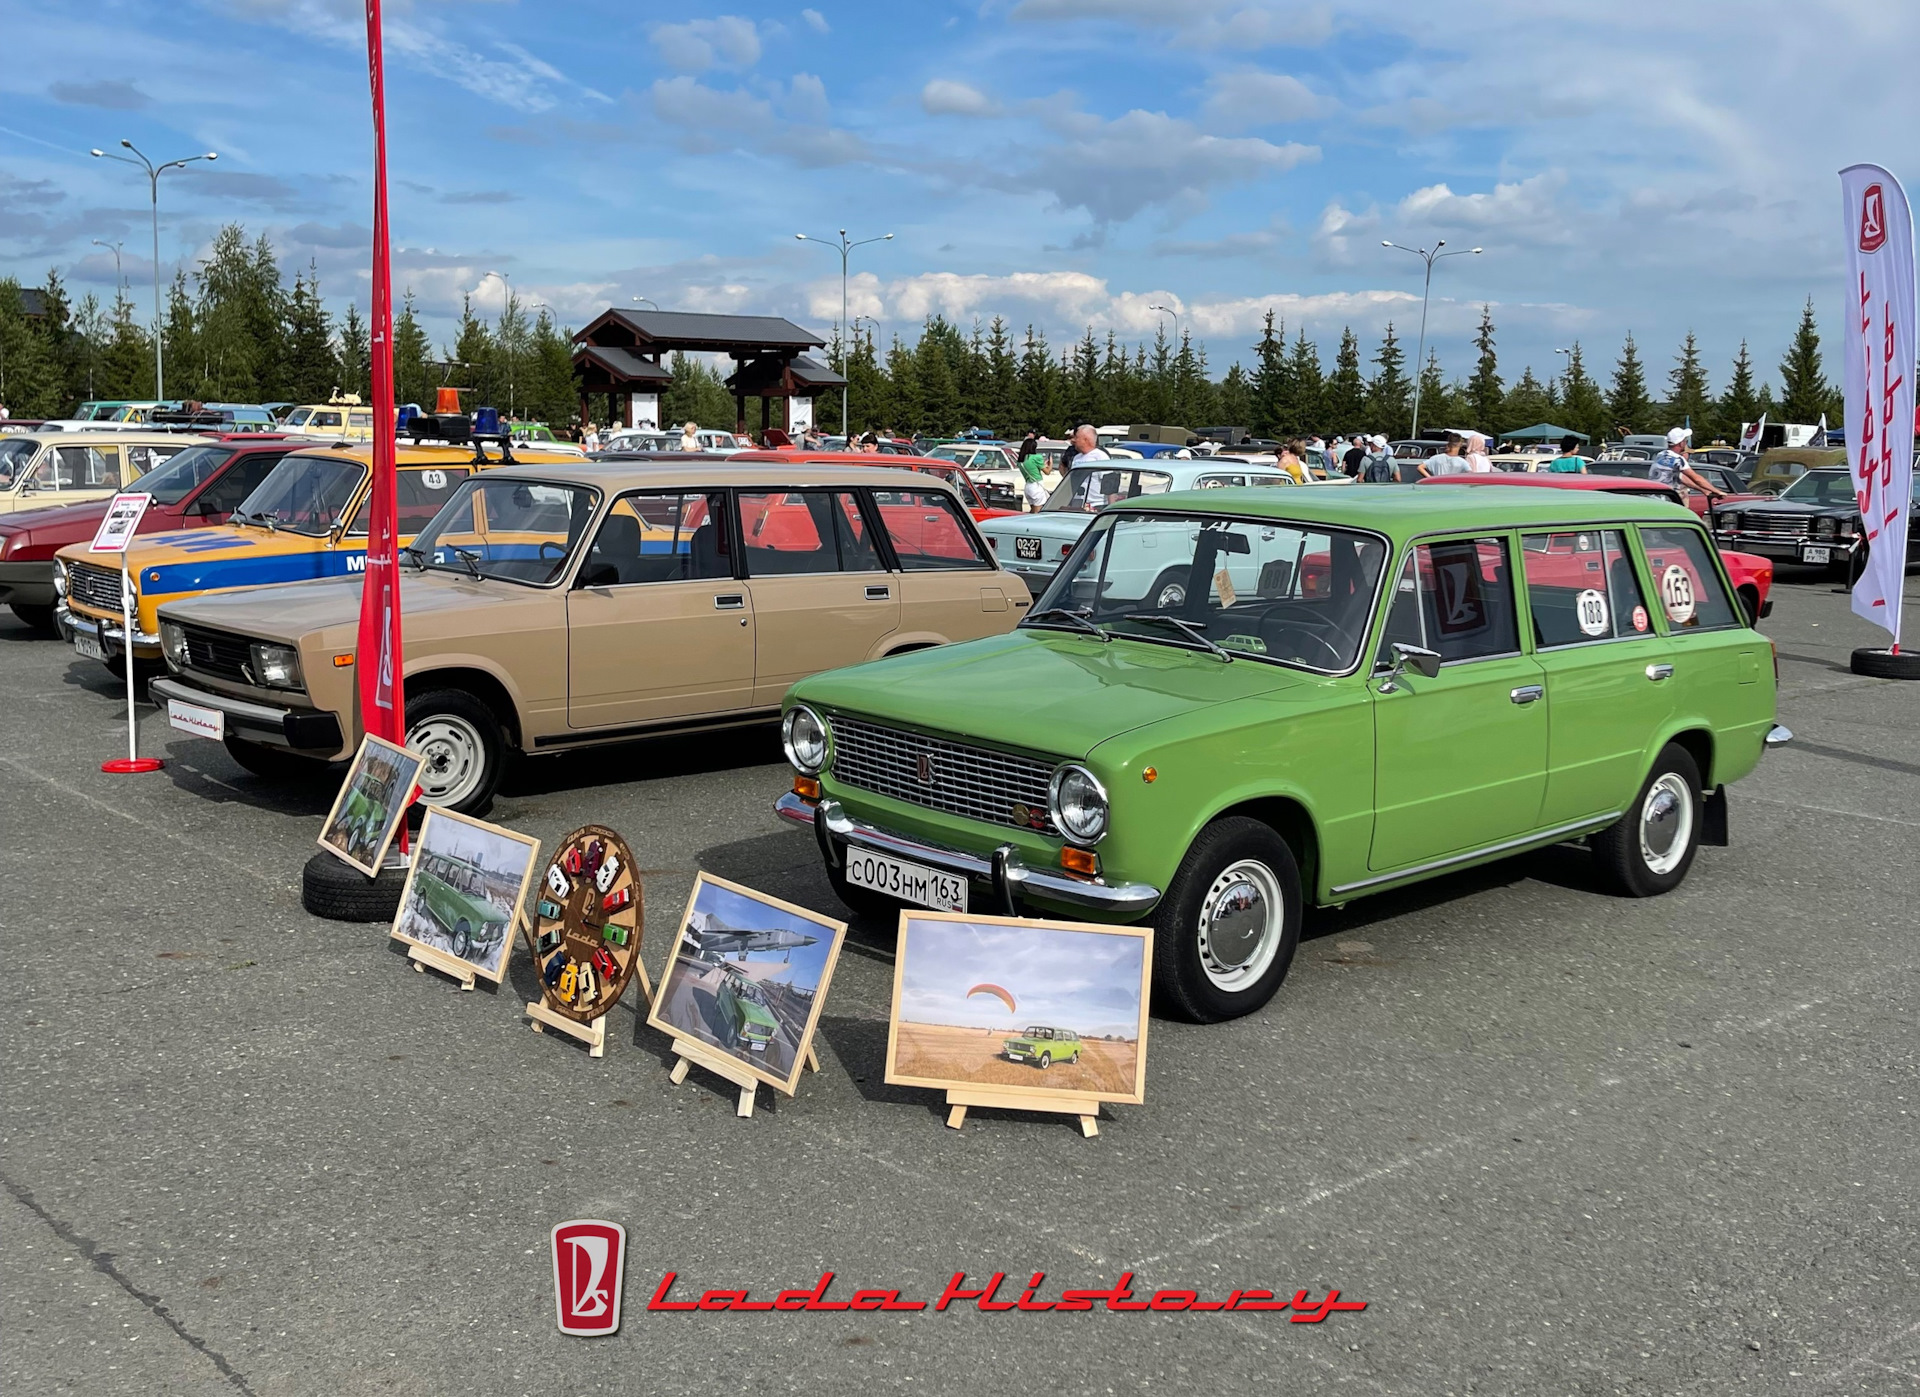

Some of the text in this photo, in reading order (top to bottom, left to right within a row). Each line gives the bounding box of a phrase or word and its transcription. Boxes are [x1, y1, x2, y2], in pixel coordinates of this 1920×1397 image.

[428, 474, 442, 485] 43
[1017, 538, 1040, 551] 02-27
[1666, 577, 1691, 607] 163
[1582, 600, 1603, 624] 188
[852, 858, 960, 902] С003НМ 163
[936, 897, 952, 909] RUS
[566, 928, 599, 948] Lada
